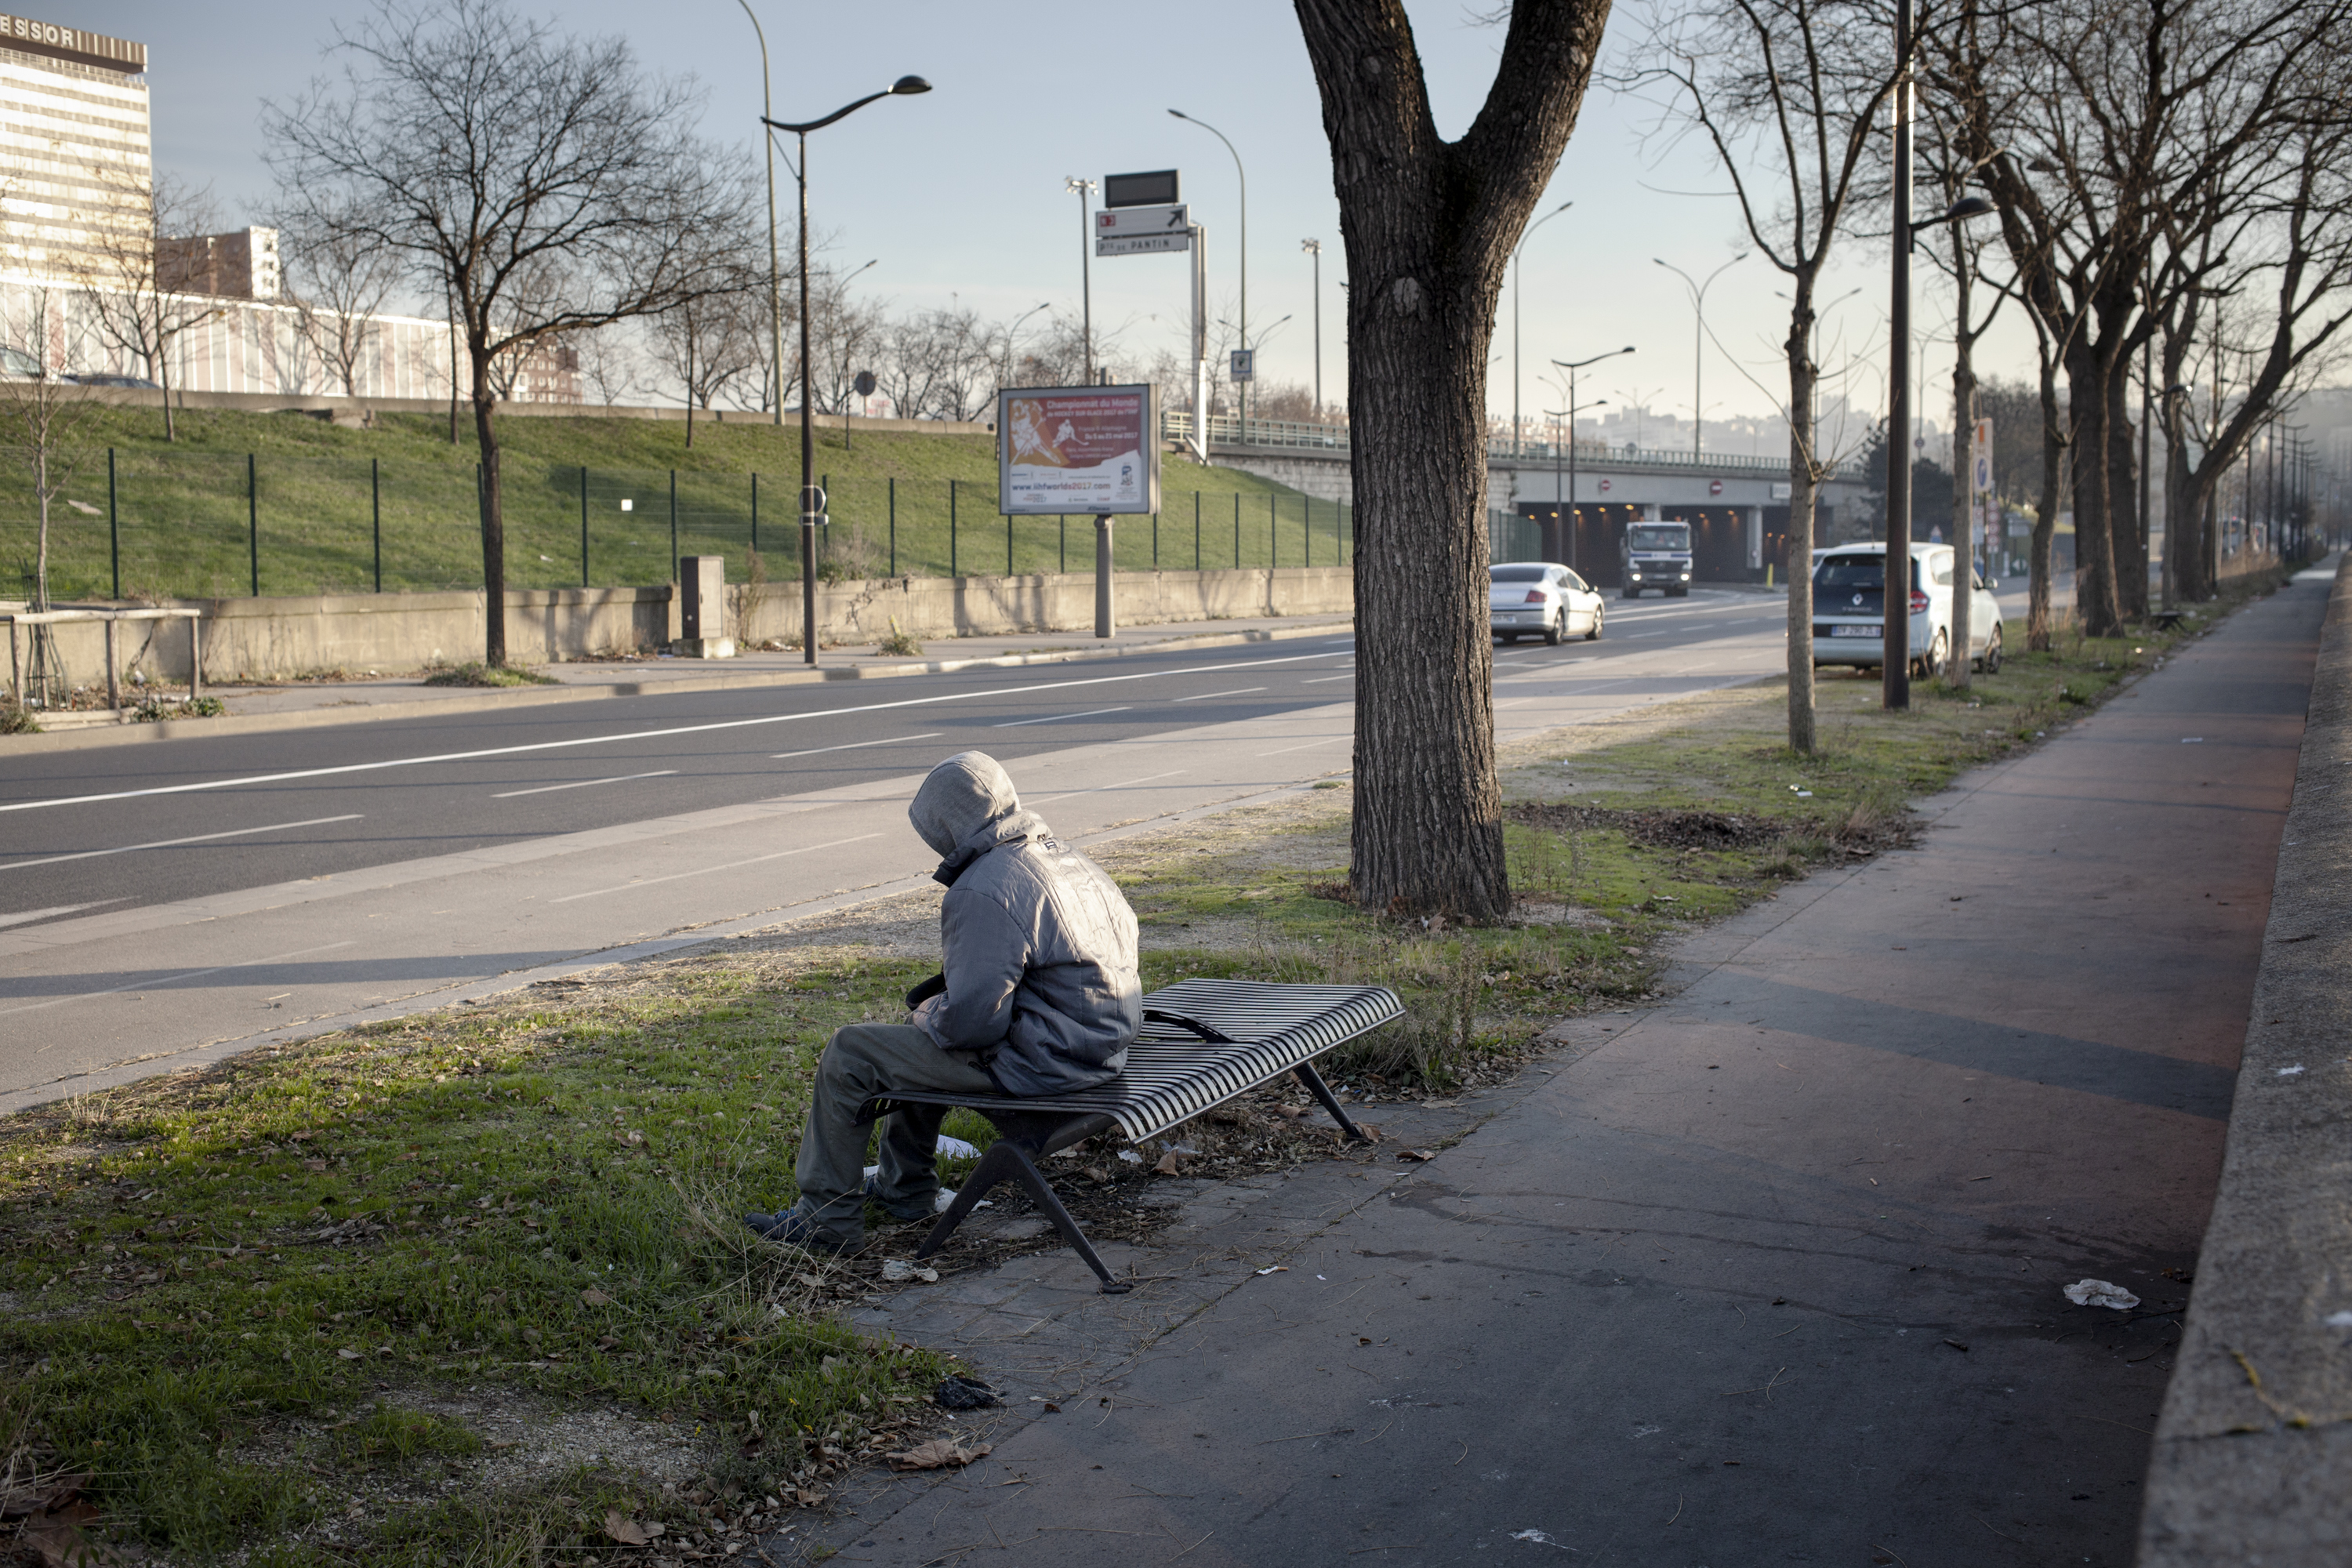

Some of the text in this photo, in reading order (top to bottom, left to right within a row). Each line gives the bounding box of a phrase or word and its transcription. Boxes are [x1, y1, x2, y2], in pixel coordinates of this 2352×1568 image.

[0, 16, 74, 47] ESSOR
[1131, 239, 1170, 249] PANTIN
[1047, 397, 1138, 410] Championnat du Monde
[1012, 482, 1111, 491] www.iihfworlds2017.com
